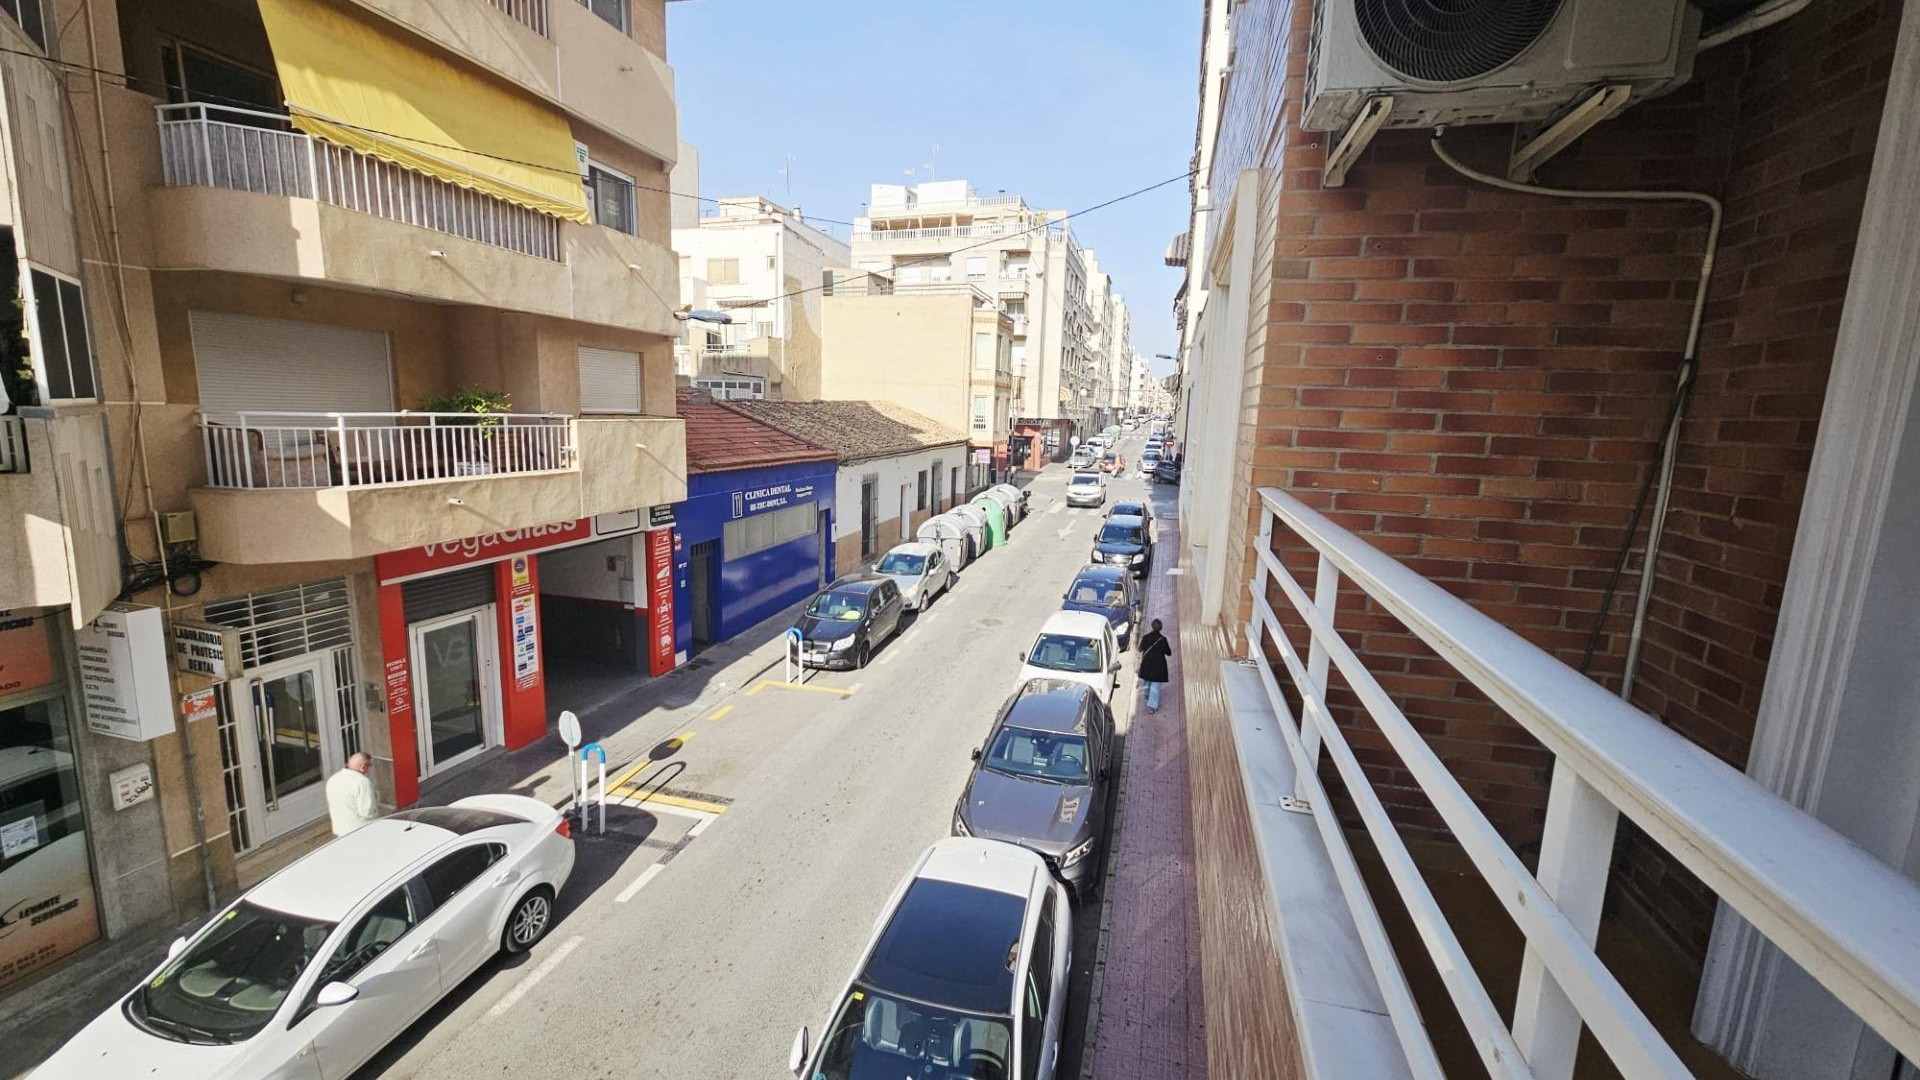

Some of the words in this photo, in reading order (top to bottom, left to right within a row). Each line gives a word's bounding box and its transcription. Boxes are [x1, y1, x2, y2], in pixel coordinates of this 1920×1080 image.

[745, 488, 770, 501] CLINICA
[770, 484, 792, 496] DENTAL
[175, 627, 222, 646] LABORATORIO
[177, 641, 187, 654] DE
[191, 644, 224, 661] PROTESIS
[188, 658, 215, 675] DENTAL
[19, 894, 61, 920] LEVANTE
[30, 898, 79, 926] SERVICIOS
